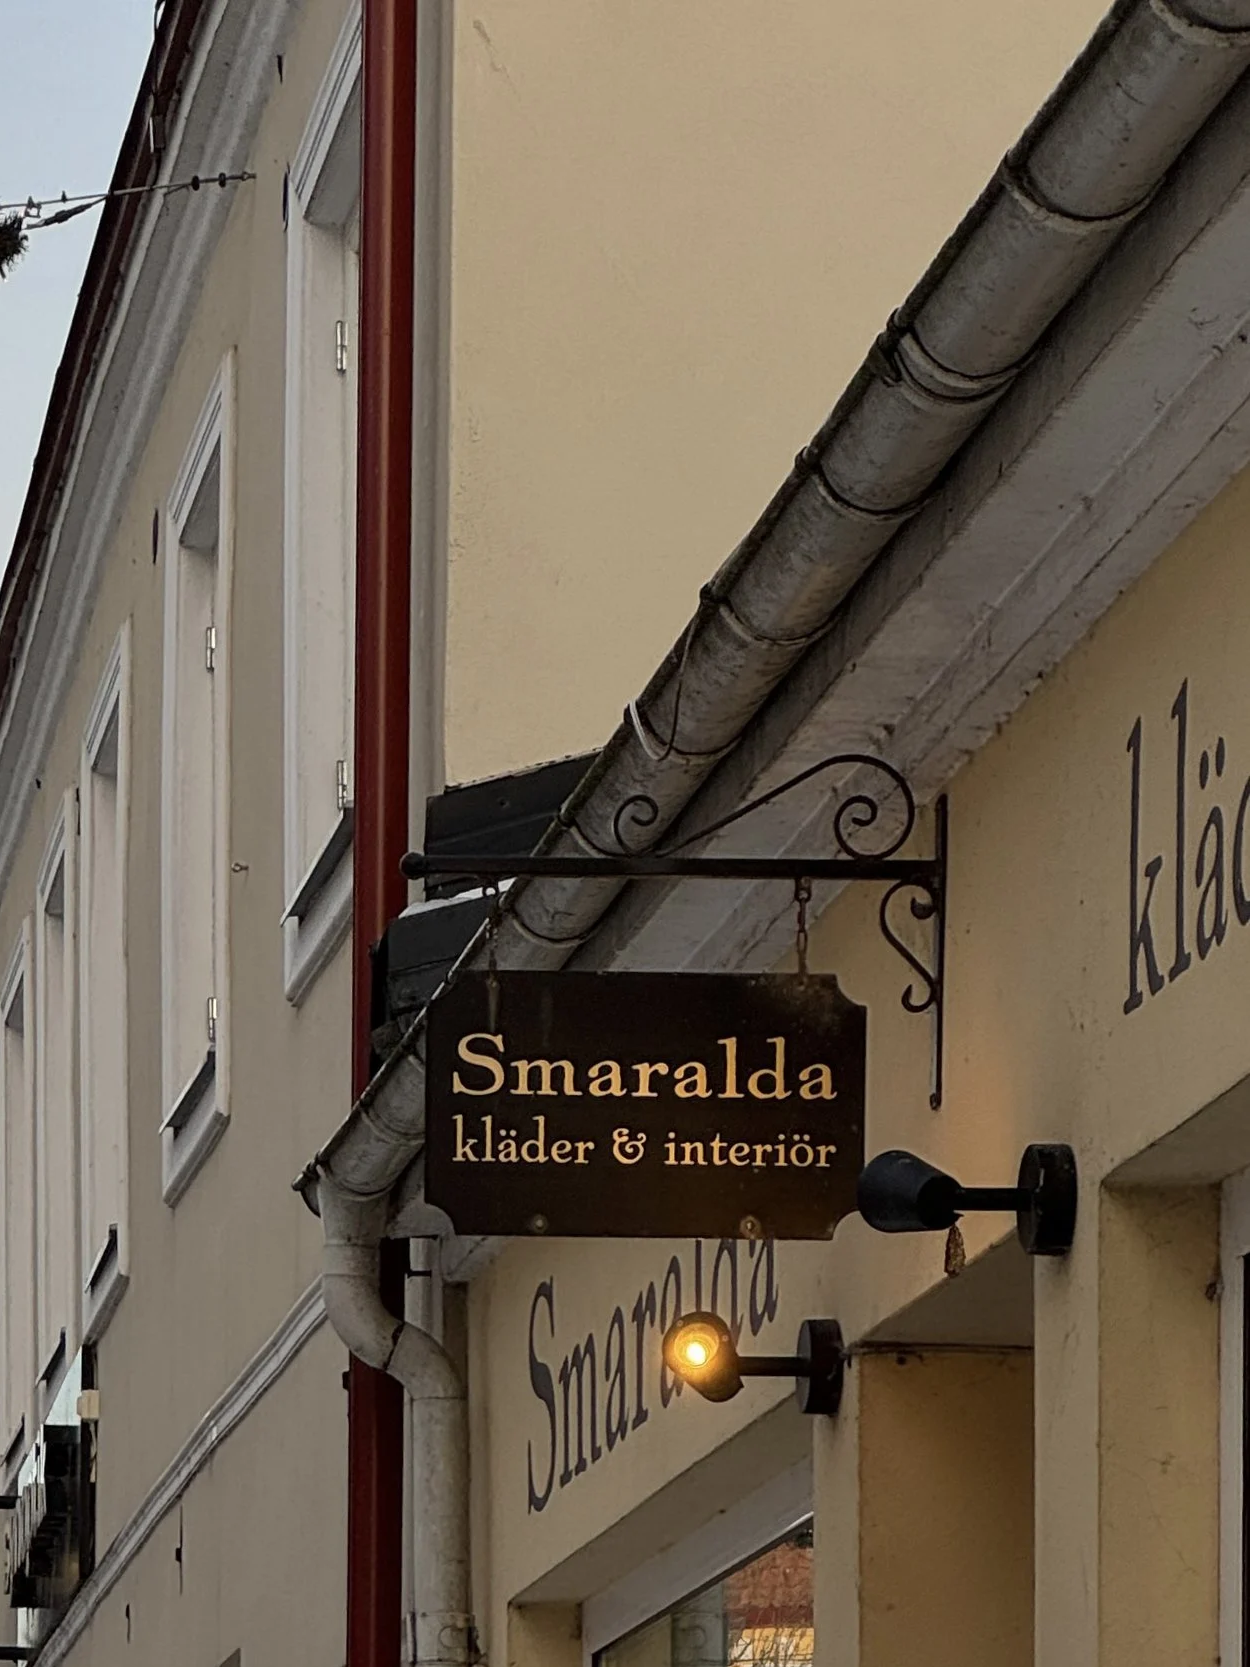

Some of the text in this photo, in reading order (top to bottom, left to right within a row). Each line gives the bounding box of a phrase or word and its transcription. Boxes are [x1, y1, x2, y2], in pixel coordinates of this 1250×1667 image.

[452, 1032, 837, 1100] Smaralda
[452, 1115, 837, 1167] kläder & interiör
